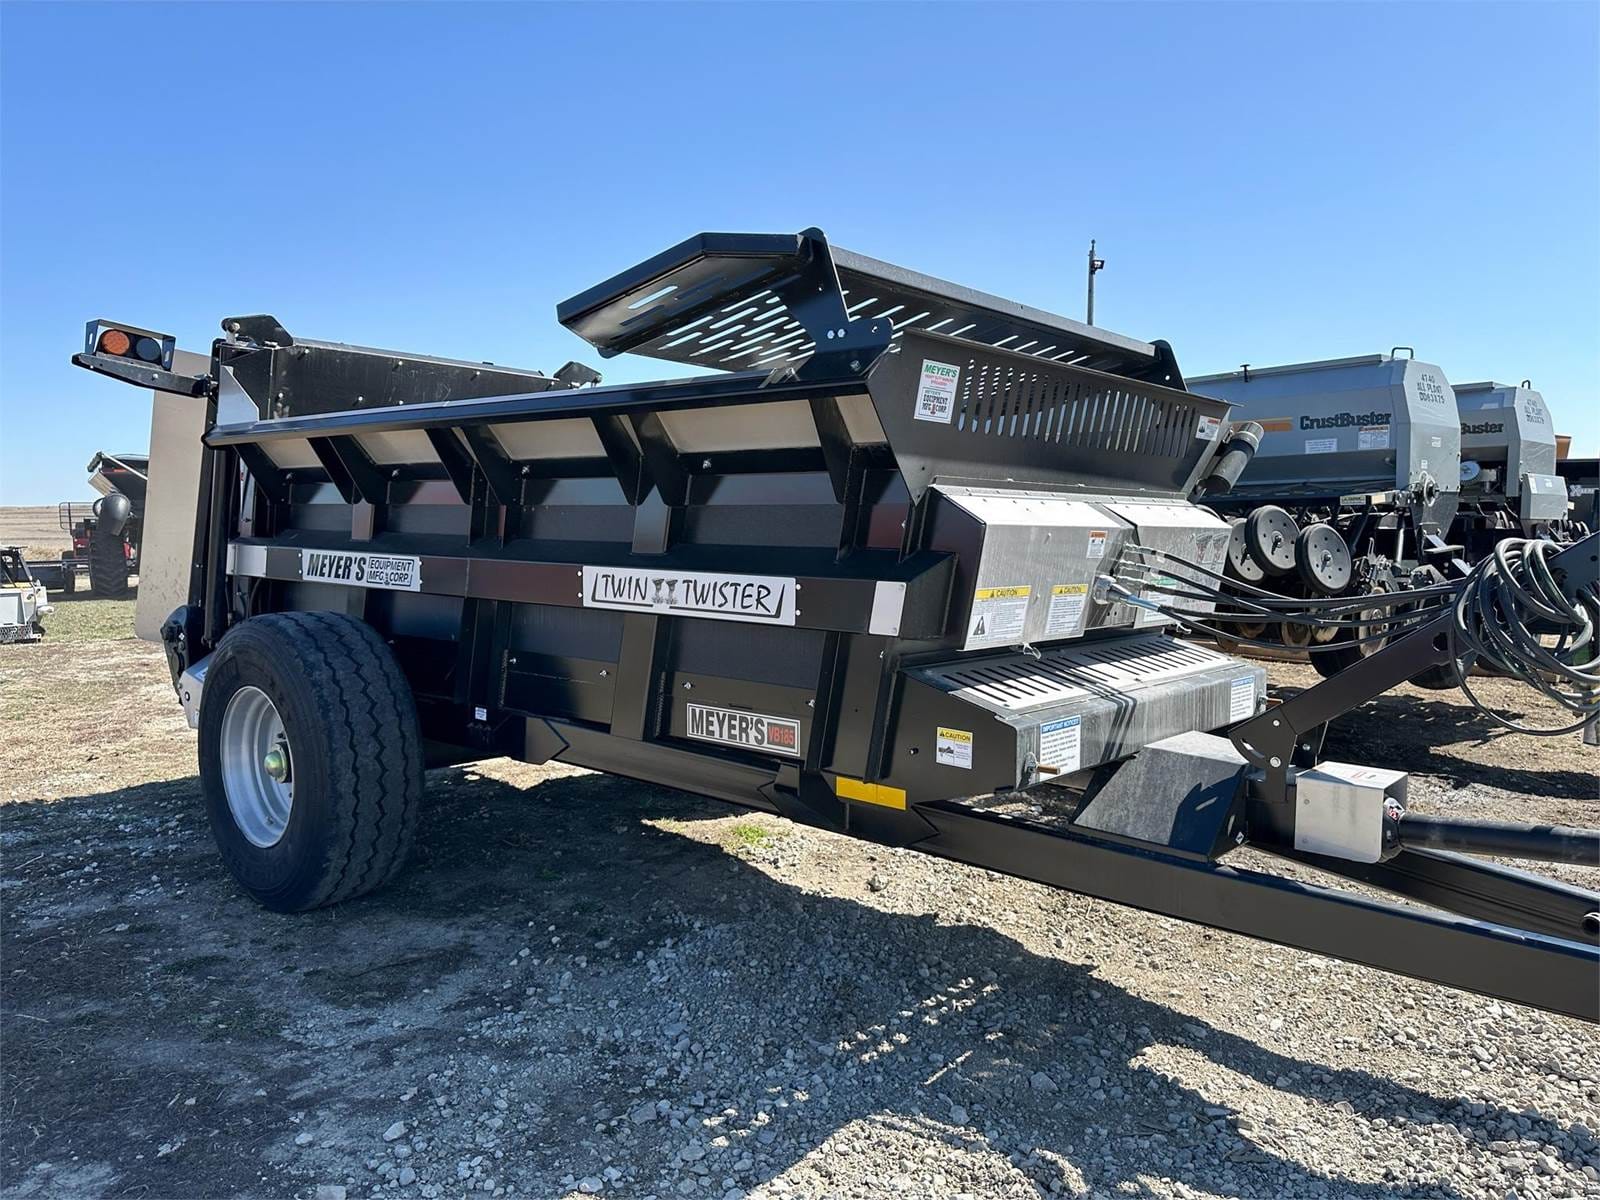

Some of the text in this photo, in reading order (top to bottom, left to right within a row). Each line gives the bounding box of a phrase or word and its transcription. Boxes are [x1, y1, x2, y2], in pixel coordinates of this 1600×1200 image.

[924, 364, 957, 378] MEYER'S
[1300, 412, 1391, 430] CrustBuster
[307, 554, 366, 581] MEYER'S
[370, 560, 412, 572] EQUIPMENT
[602, 574, 772, 613] TWIN TWISTER
[996, 589, 1018, 597] CAUTION
[691, 708, 765, 745] MEYER'S
[944, 731, 971, 741] CAUTION
